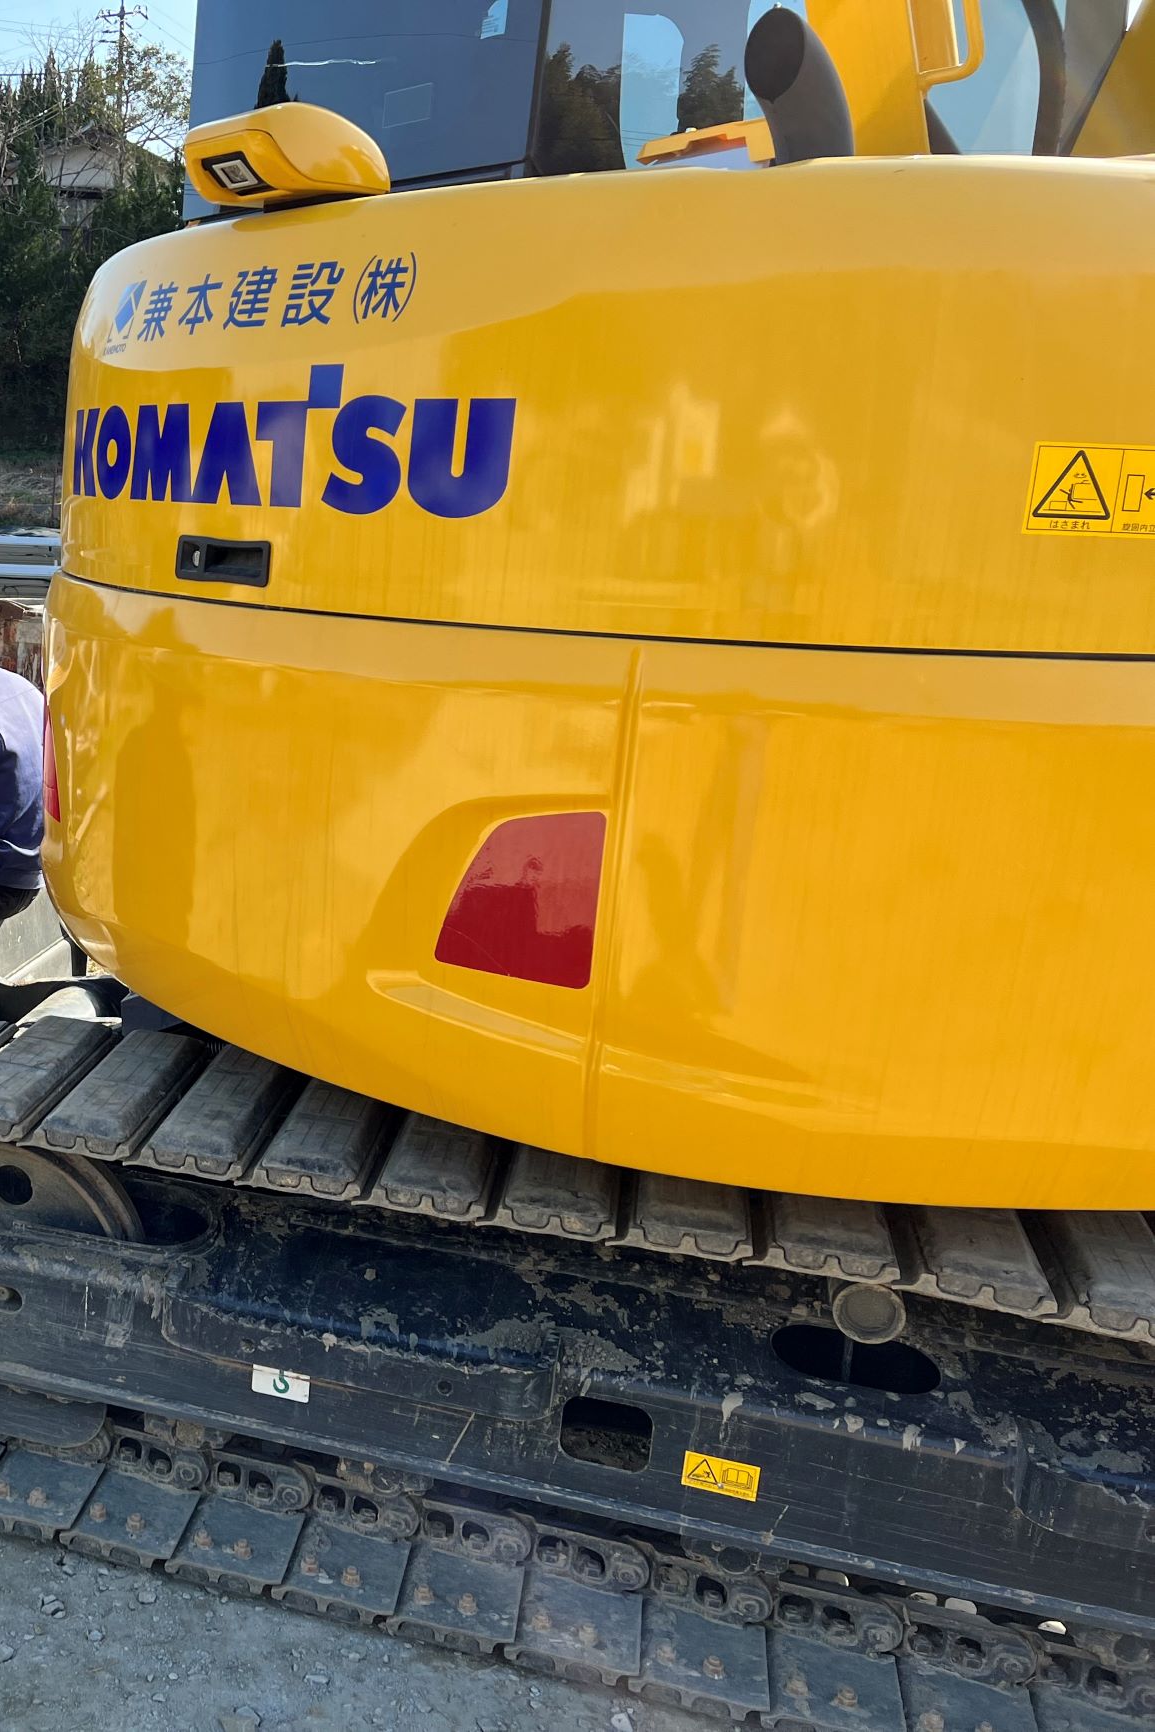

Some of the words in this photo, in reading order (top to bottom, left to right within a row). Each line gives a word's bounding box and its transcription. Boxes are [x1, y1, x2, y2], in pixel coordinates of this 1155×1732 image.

[137, 251, 417, 342] 兼本建設(株)
[73, 363, 517, 519] KOMATSU
[1049, 520, 1091, 530] はさまれ
